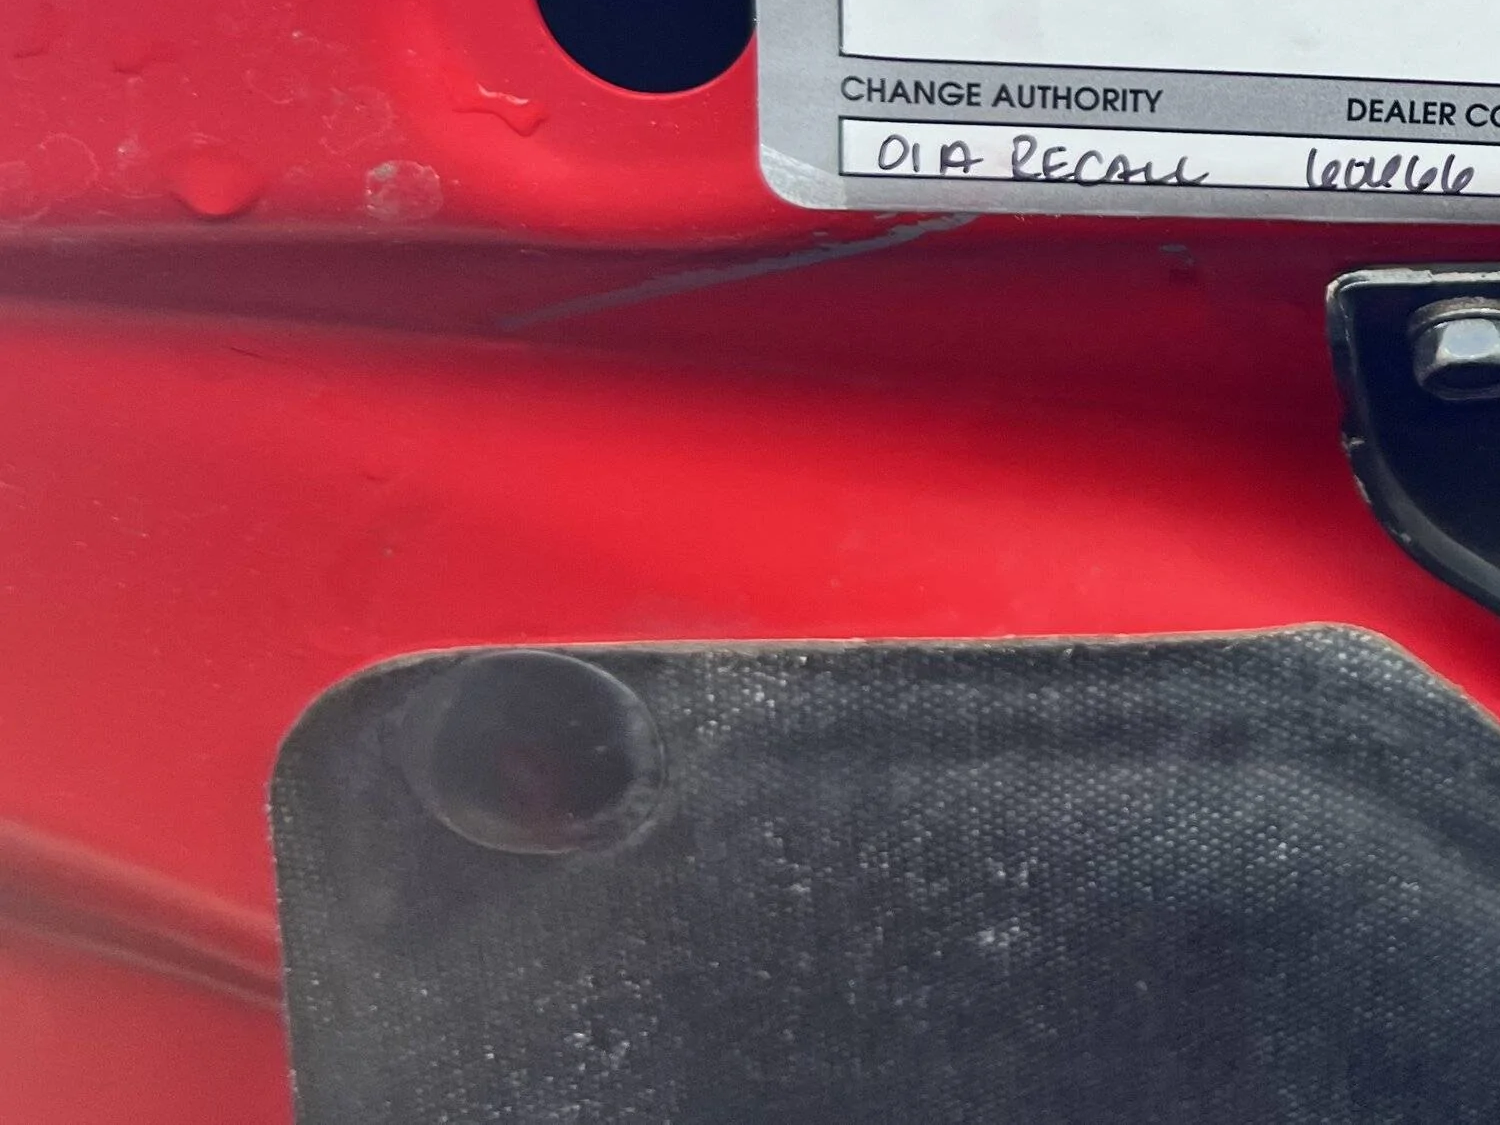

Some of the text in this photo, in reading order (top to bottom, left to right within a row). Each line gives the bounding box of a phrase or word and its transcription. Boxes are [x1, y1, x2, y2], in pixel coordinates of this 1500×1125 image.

[841, 76, 1163, 113] CHANGE AUTHORITY
[1347, 98, 1456, 126] DEALER
